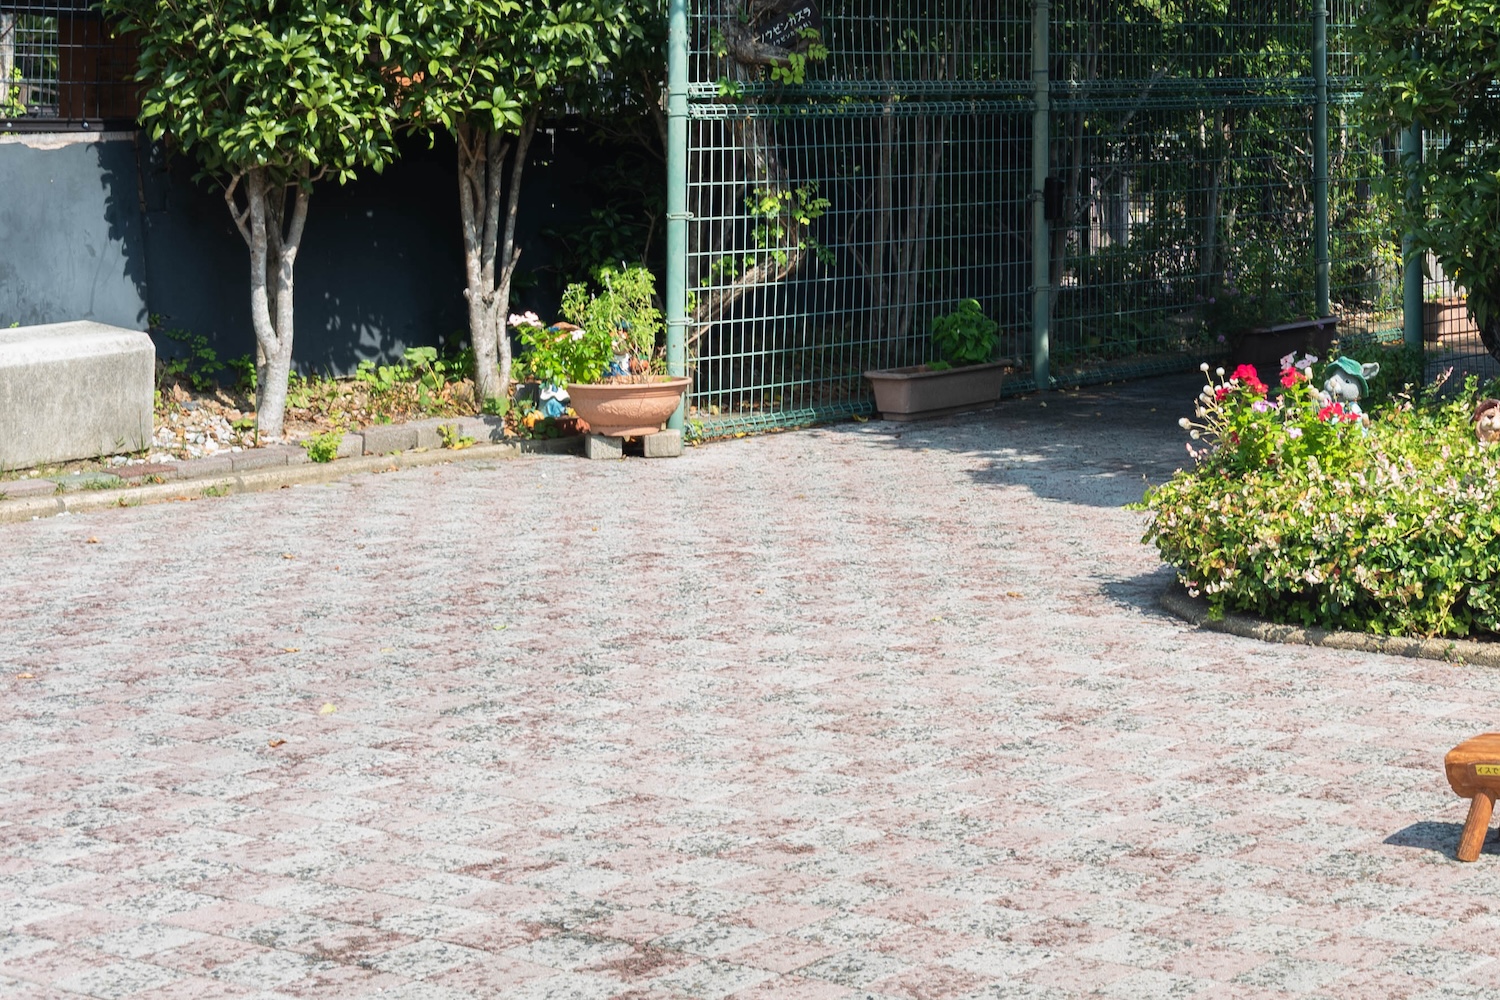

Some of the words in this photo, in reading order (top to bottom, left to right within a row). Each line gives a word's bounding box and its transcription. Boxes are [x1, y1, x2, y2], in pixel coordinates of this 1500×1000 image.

[761, 6, 812, 44] ノウゼンカズラ
